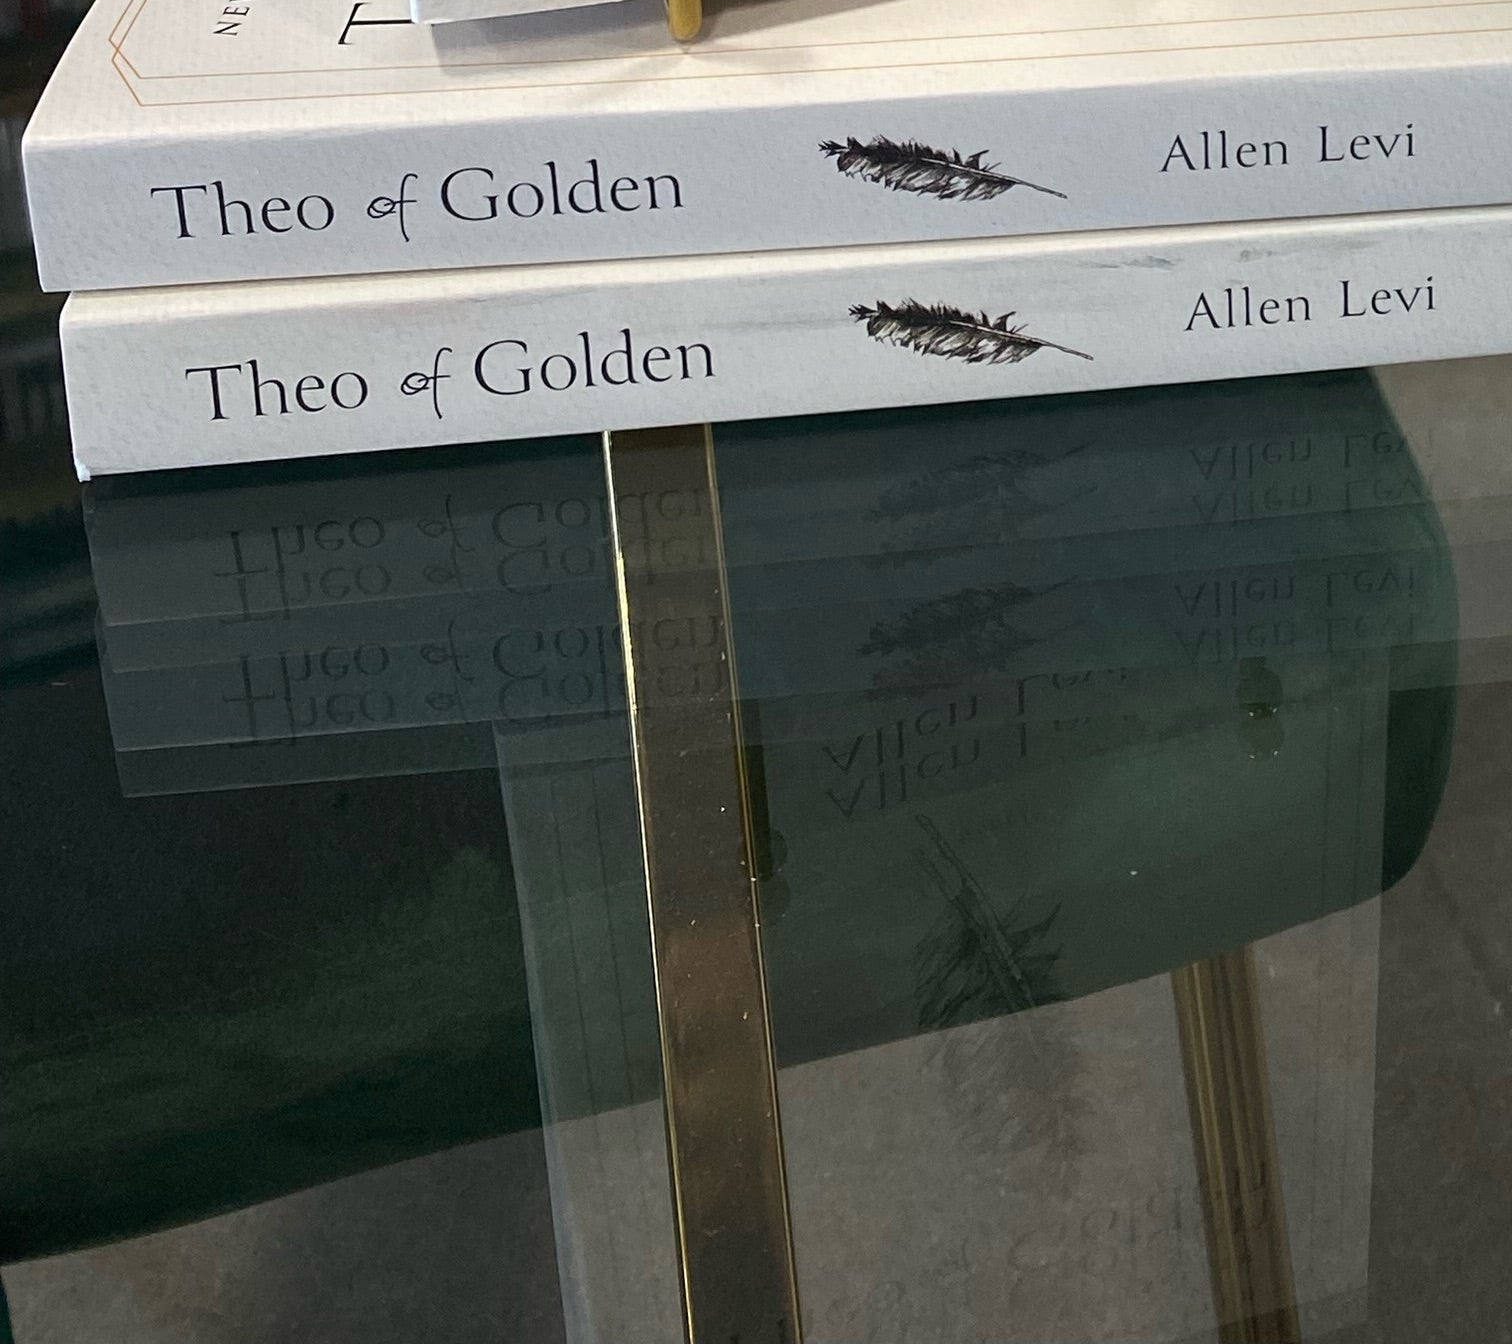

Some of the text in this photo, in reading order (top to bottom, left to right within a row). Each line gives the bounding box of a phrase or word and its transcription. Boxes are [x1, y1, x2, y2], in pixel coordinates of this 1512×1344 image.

[1161, 123, 1417, 174] Allen Levi
[151, 159, 684, 242] Theo of Golden
[1185, 275, 1437, 332] Allen Levi
[185, 328, 717, 421] Theo of Golden
